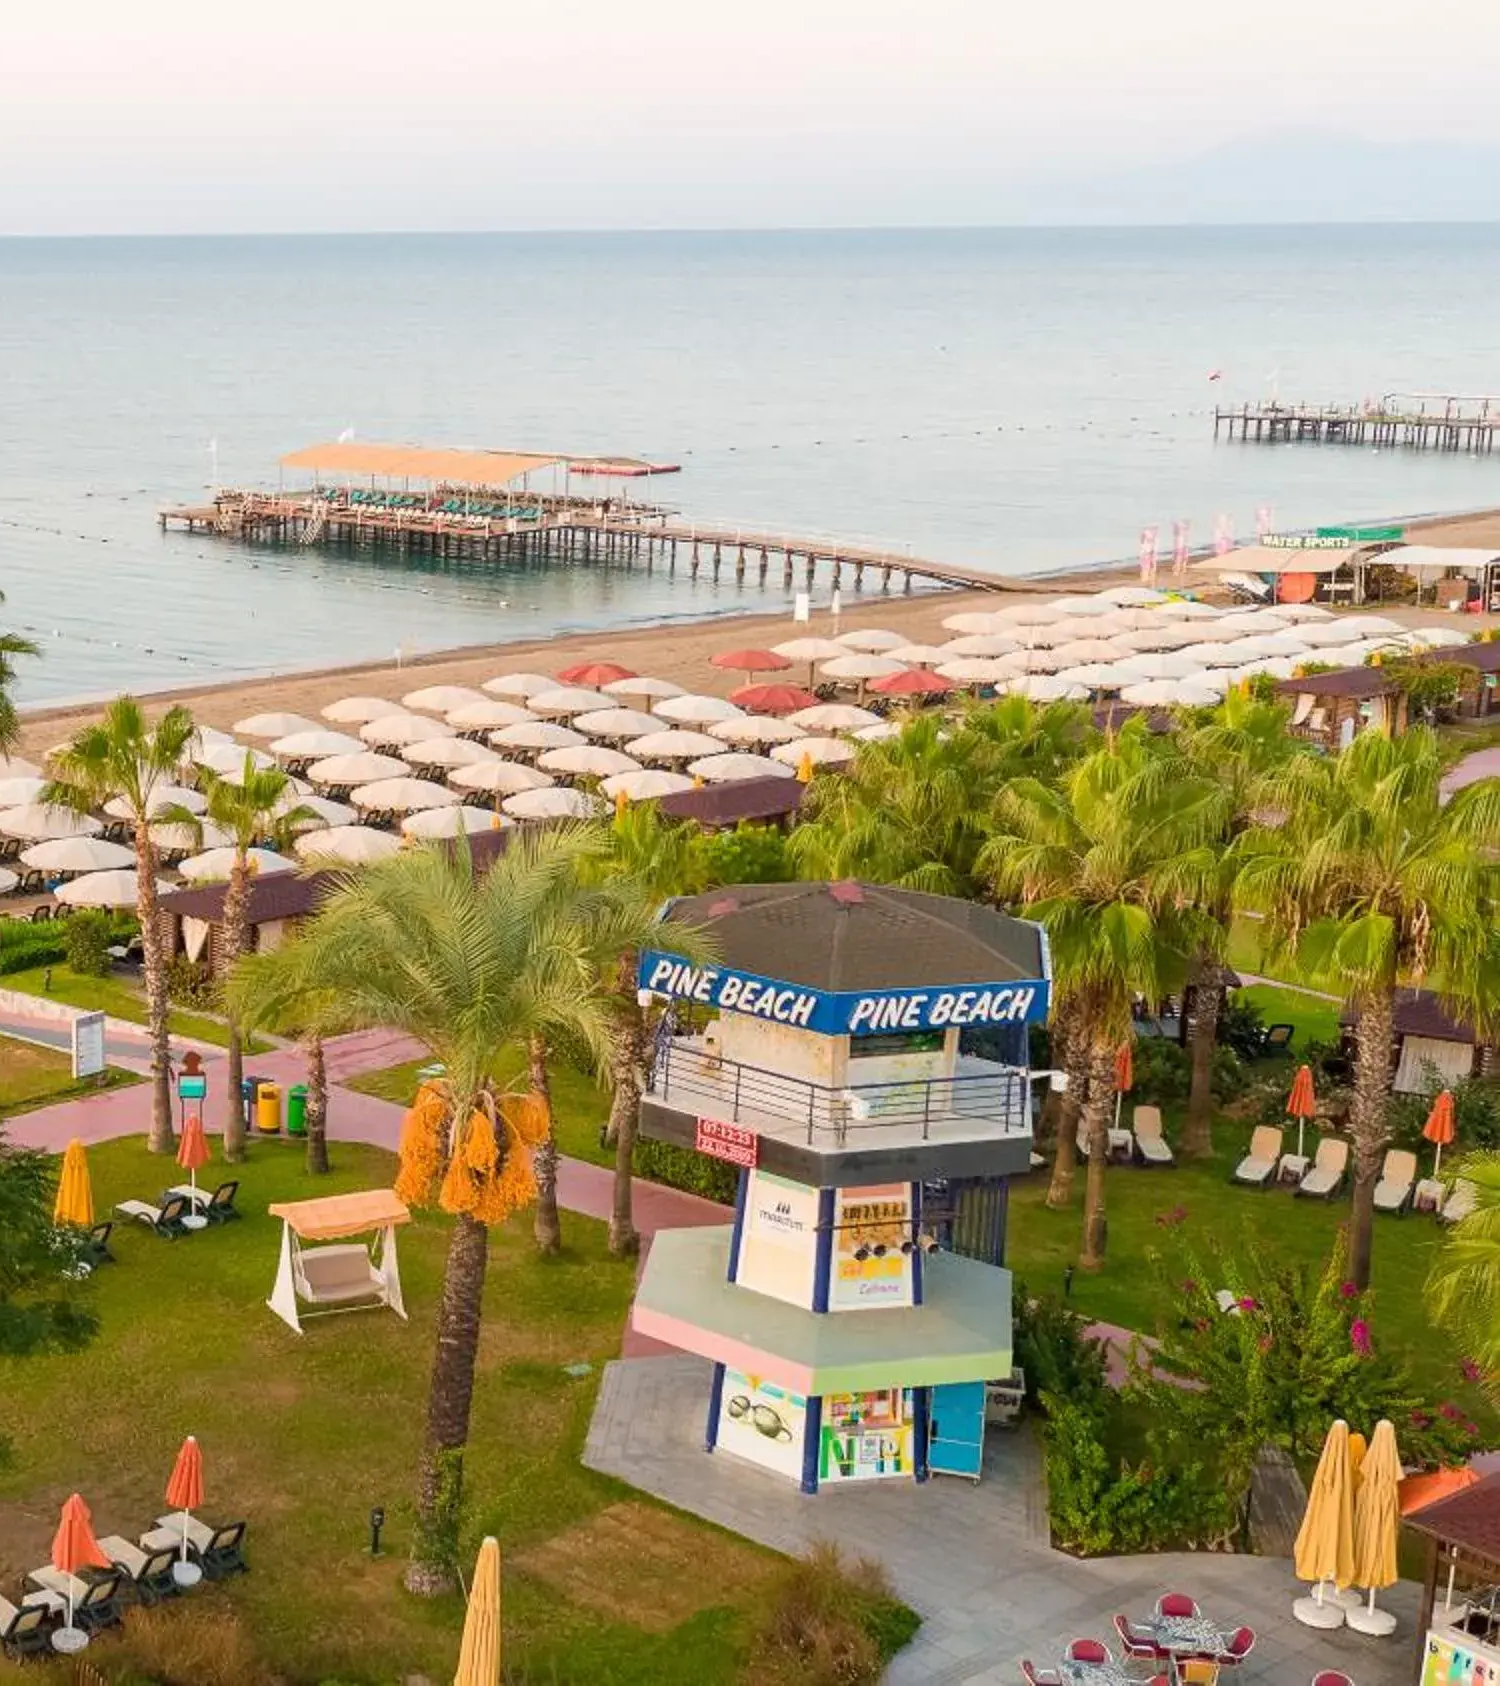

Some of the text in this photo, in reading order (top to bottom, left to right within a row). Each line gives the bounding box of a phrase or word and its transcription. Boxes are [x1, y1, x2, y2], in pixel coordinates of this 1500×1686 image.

[1261, 535, 1350, 548] WATER SPORTS
[649, 959, 817, 1027] PINE BEACH
[849, 987, 1035, 1031] PINE BEACH
